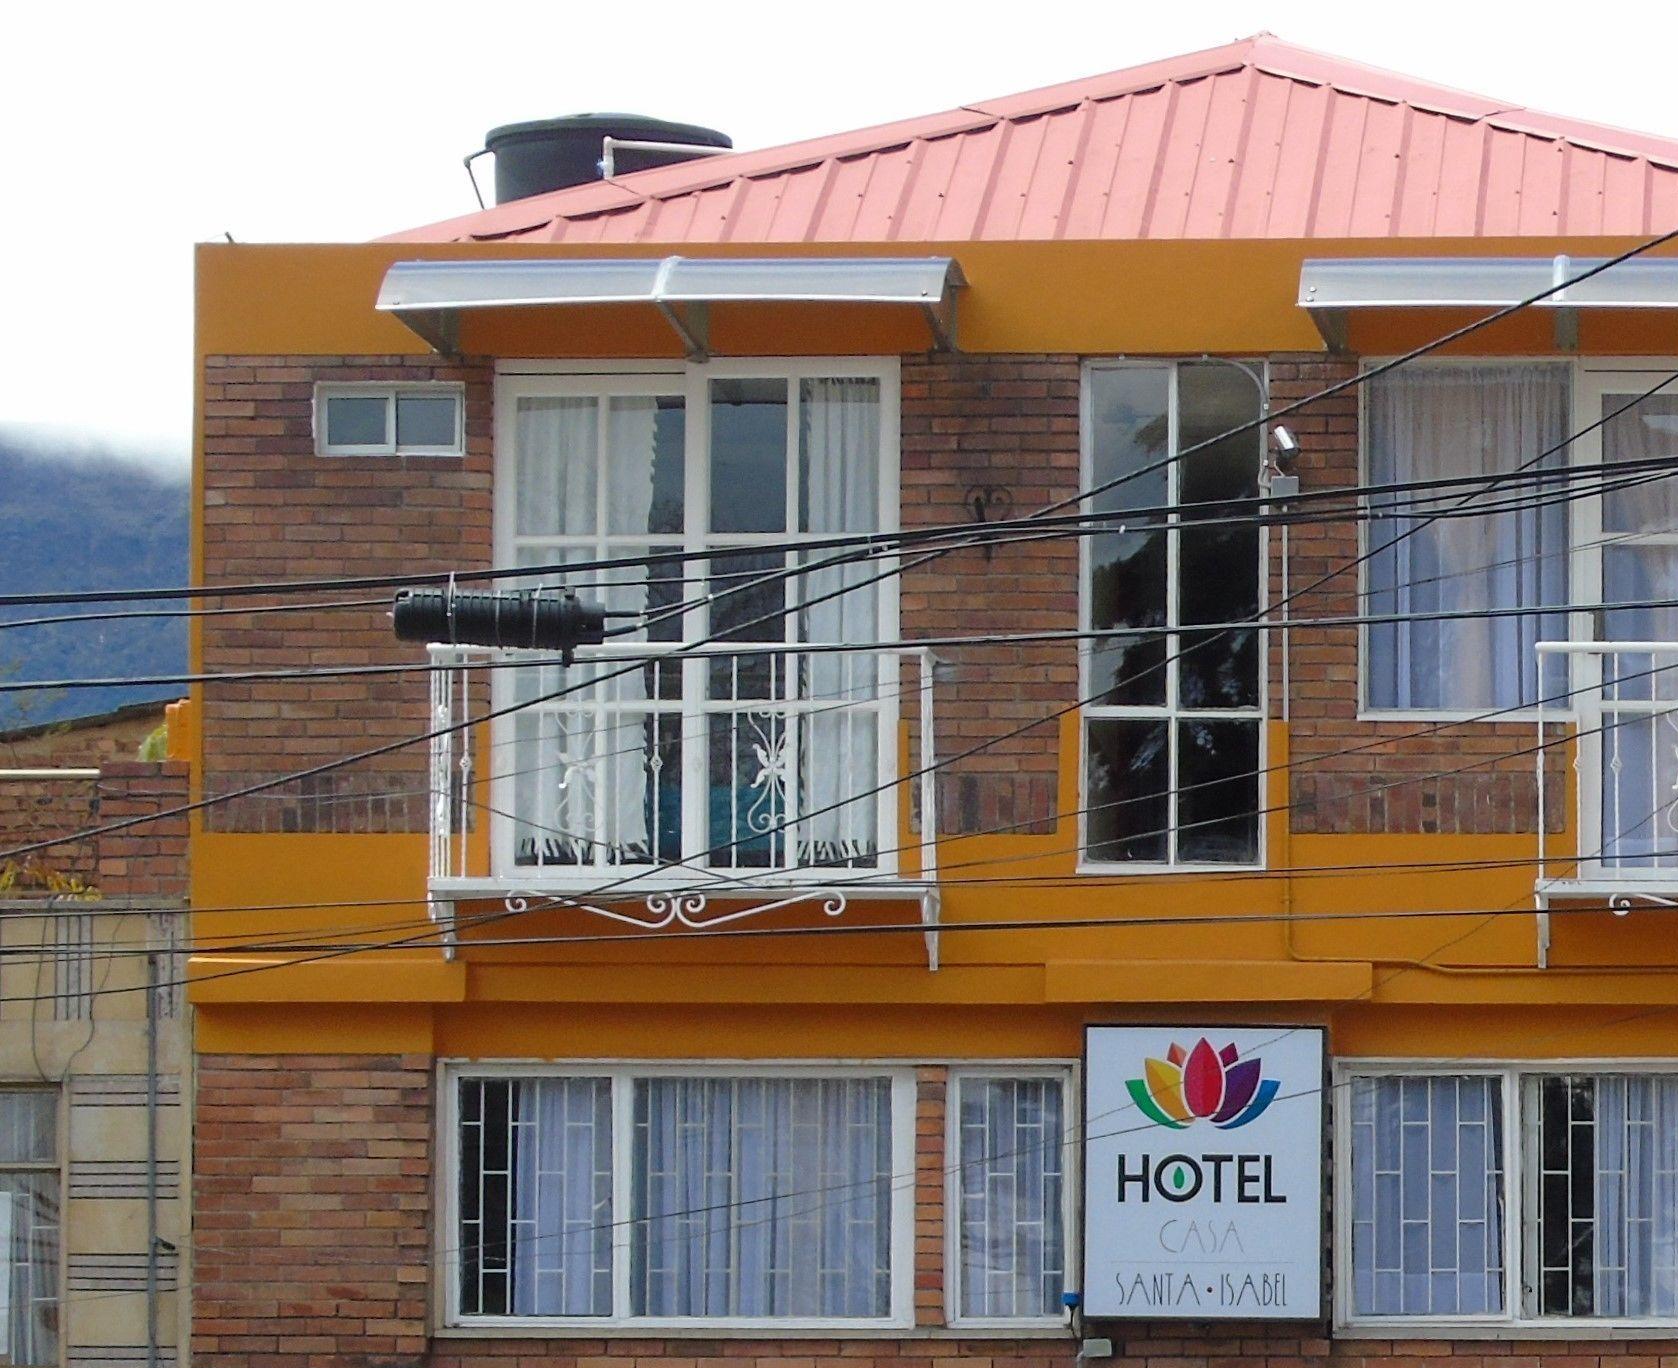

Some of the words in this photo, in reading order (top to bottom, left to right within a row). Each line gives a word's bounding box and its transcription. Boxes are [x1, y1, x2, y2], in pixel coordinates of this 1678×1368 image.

[1117, 1153, 1287, 1203] HOTEL
[1159, 1219, 1245, 1254] CASA
[1115, 1272, 1201, 1306] SANTA
[1220, 1272, 1288, 1306] ISABEL
